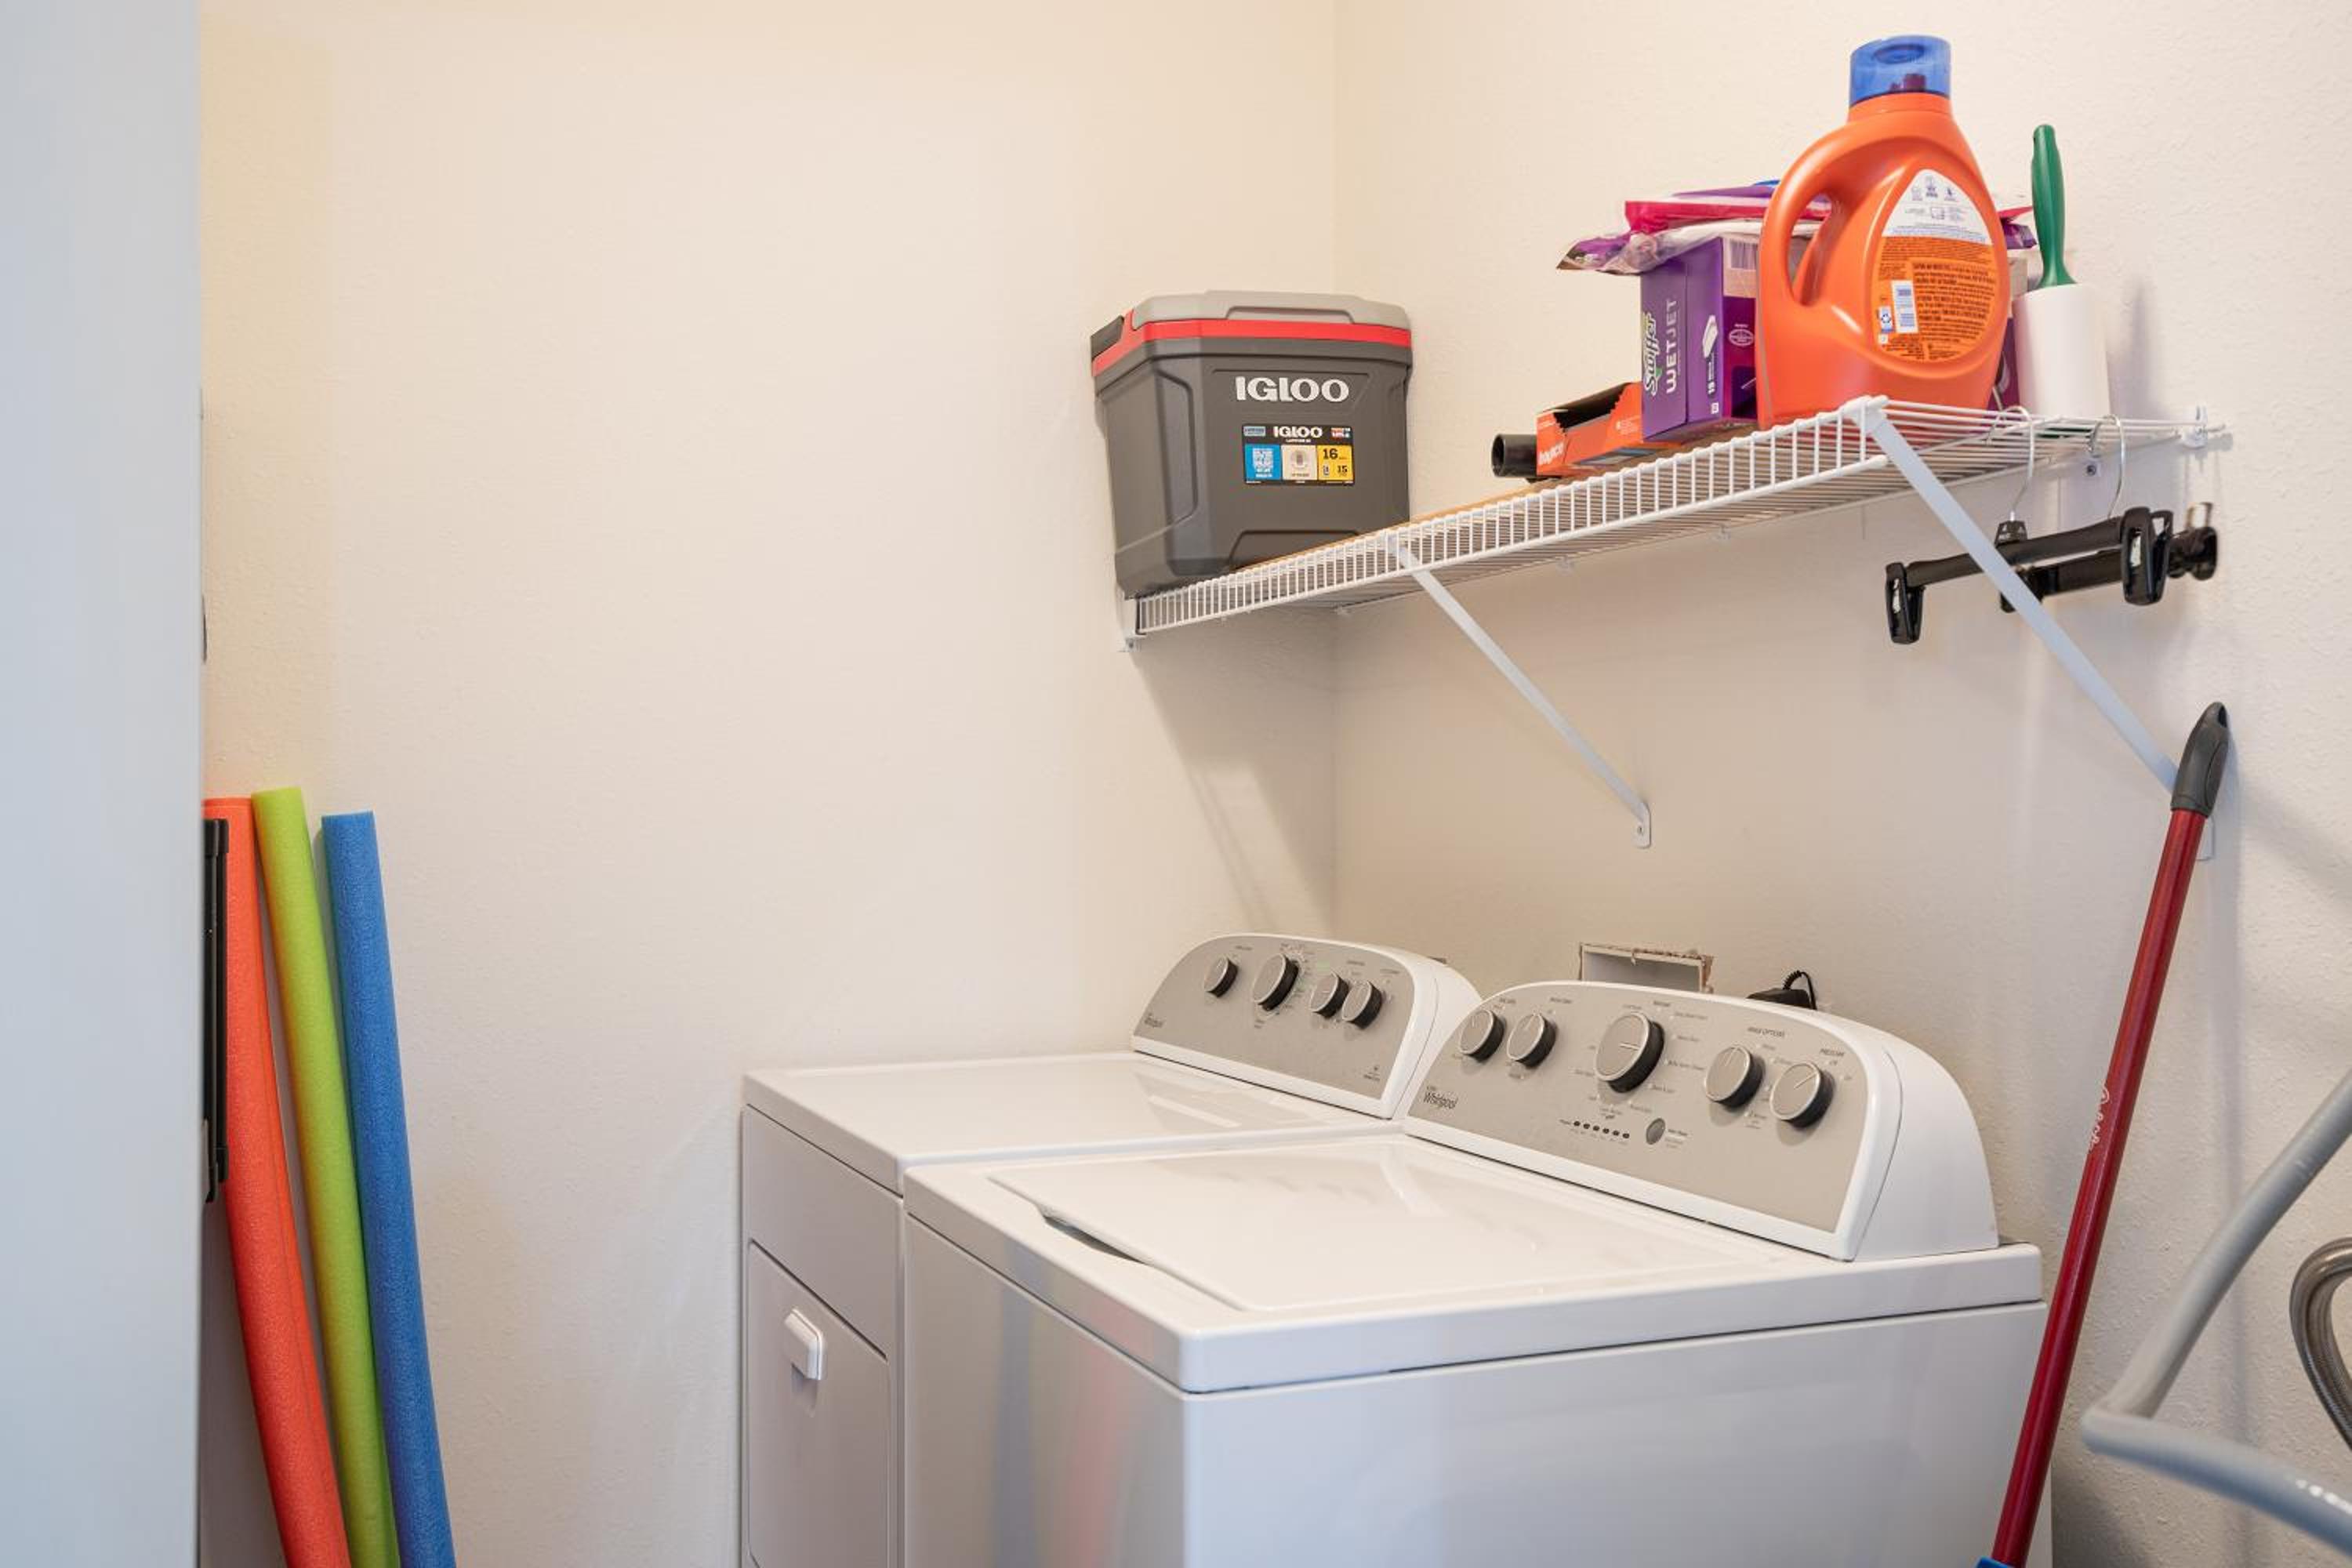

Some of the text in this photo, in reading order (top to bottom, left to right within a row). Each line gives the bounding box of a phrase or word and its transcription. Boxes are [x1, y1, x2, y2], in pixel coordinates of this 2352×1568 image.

[1642, 311, 1661, 396] Swiffer
[1666, 299, 1677, 394] WETJET
[1236, 376, 1349, 402] IGLOO
[1272, 426, 1323, 438] IGLOO
[1323, 448, 1338, 460] 16
